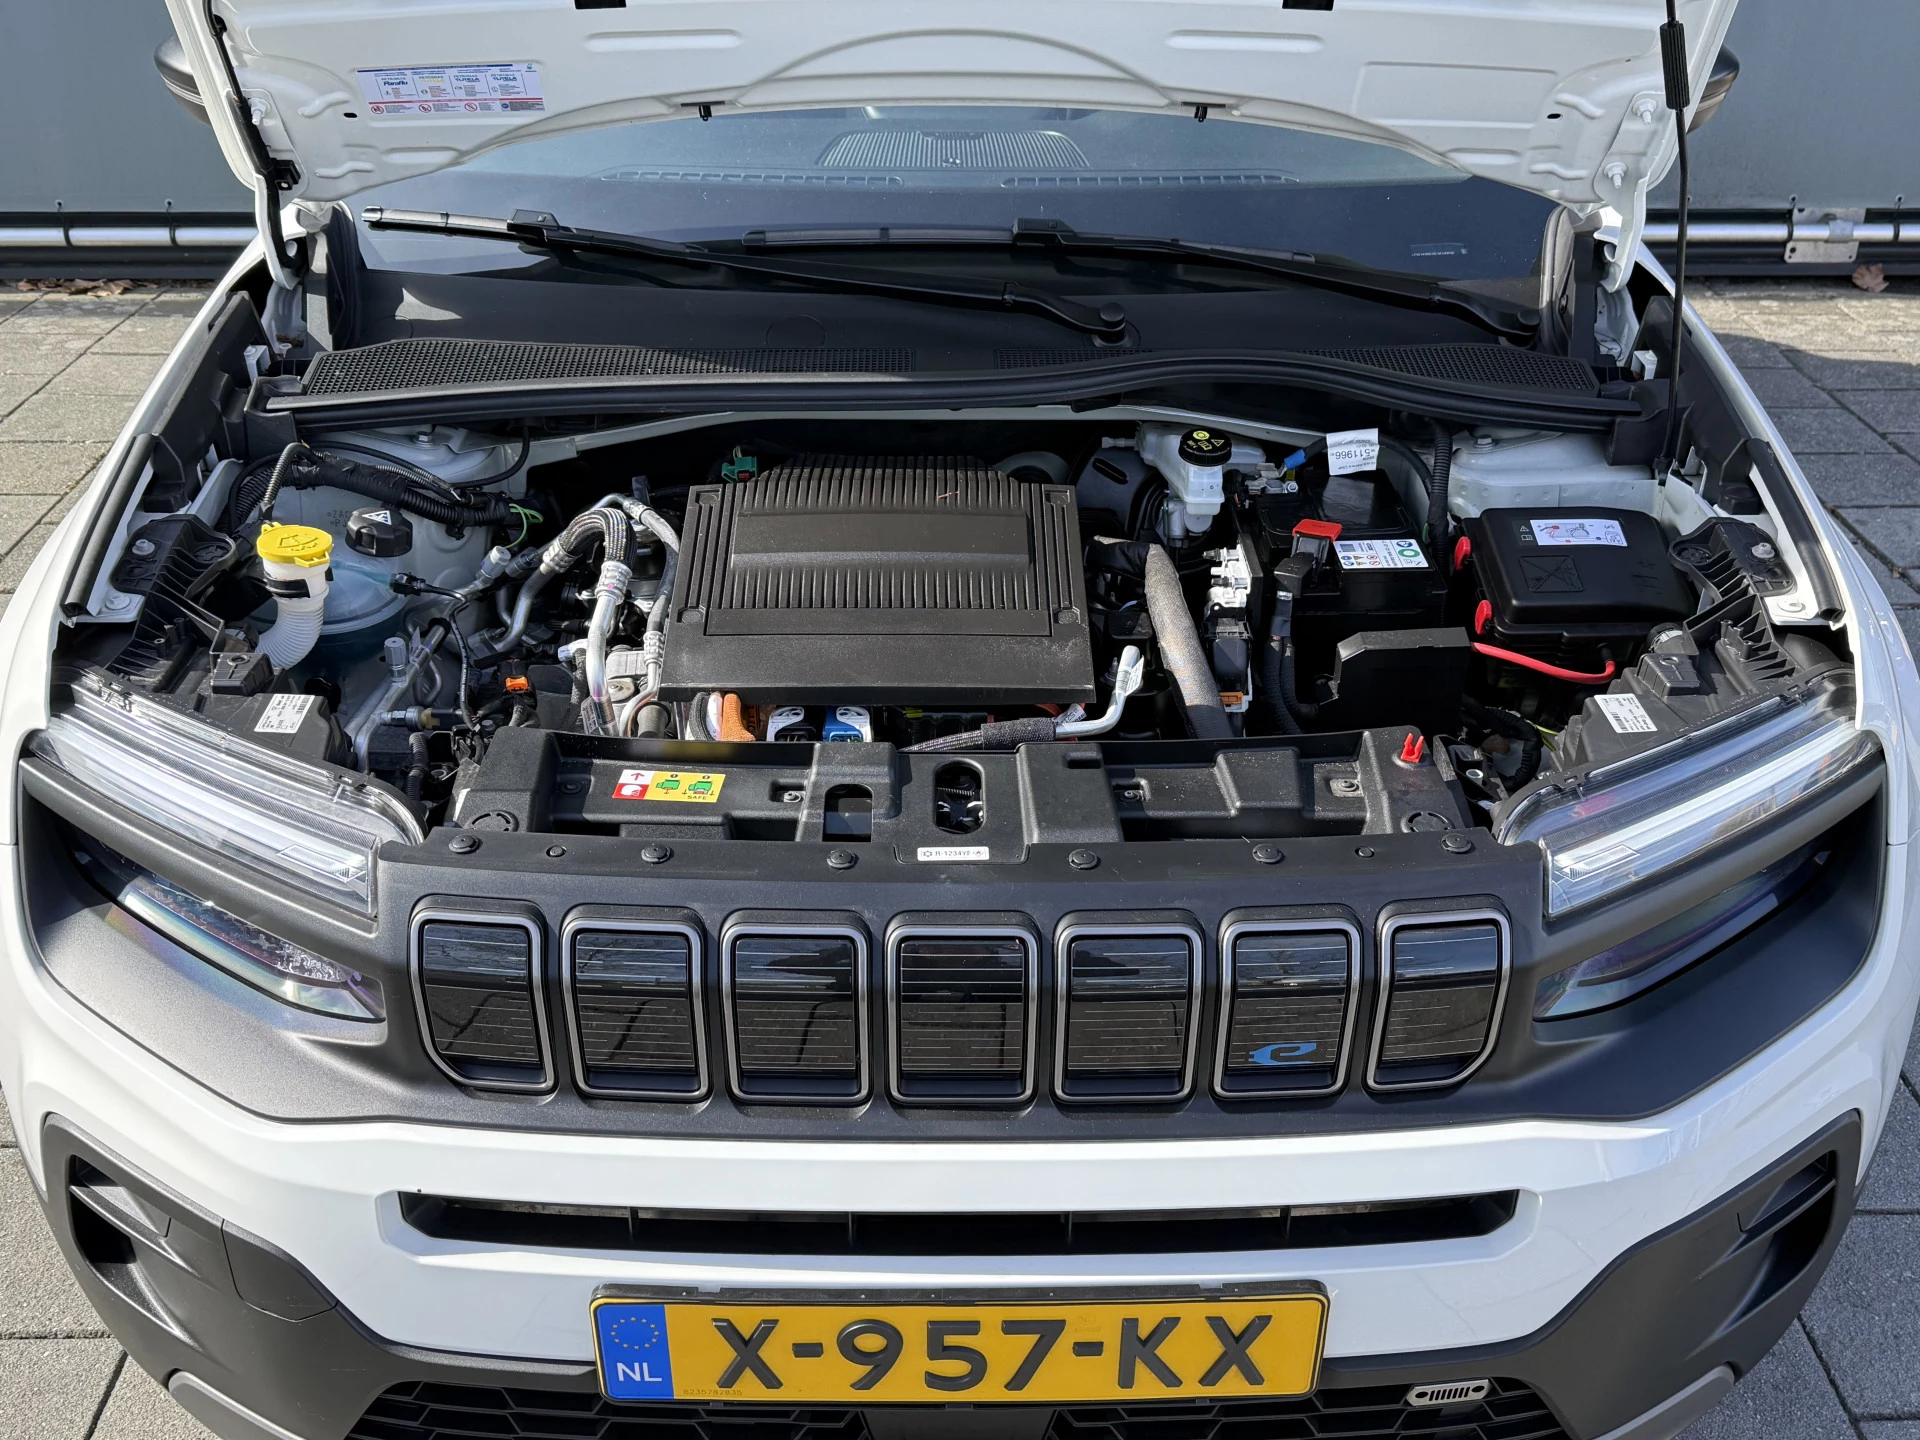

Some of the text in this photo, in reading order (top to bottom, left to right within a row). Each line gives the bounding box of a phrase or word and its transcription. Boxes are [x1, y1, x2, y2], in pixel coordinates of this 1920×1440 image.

[1335, 448, 1371, 460] 511966
[712, 1314, 1273, 1391] X-957-KX
[616, 1361, 663, 1383] NL
